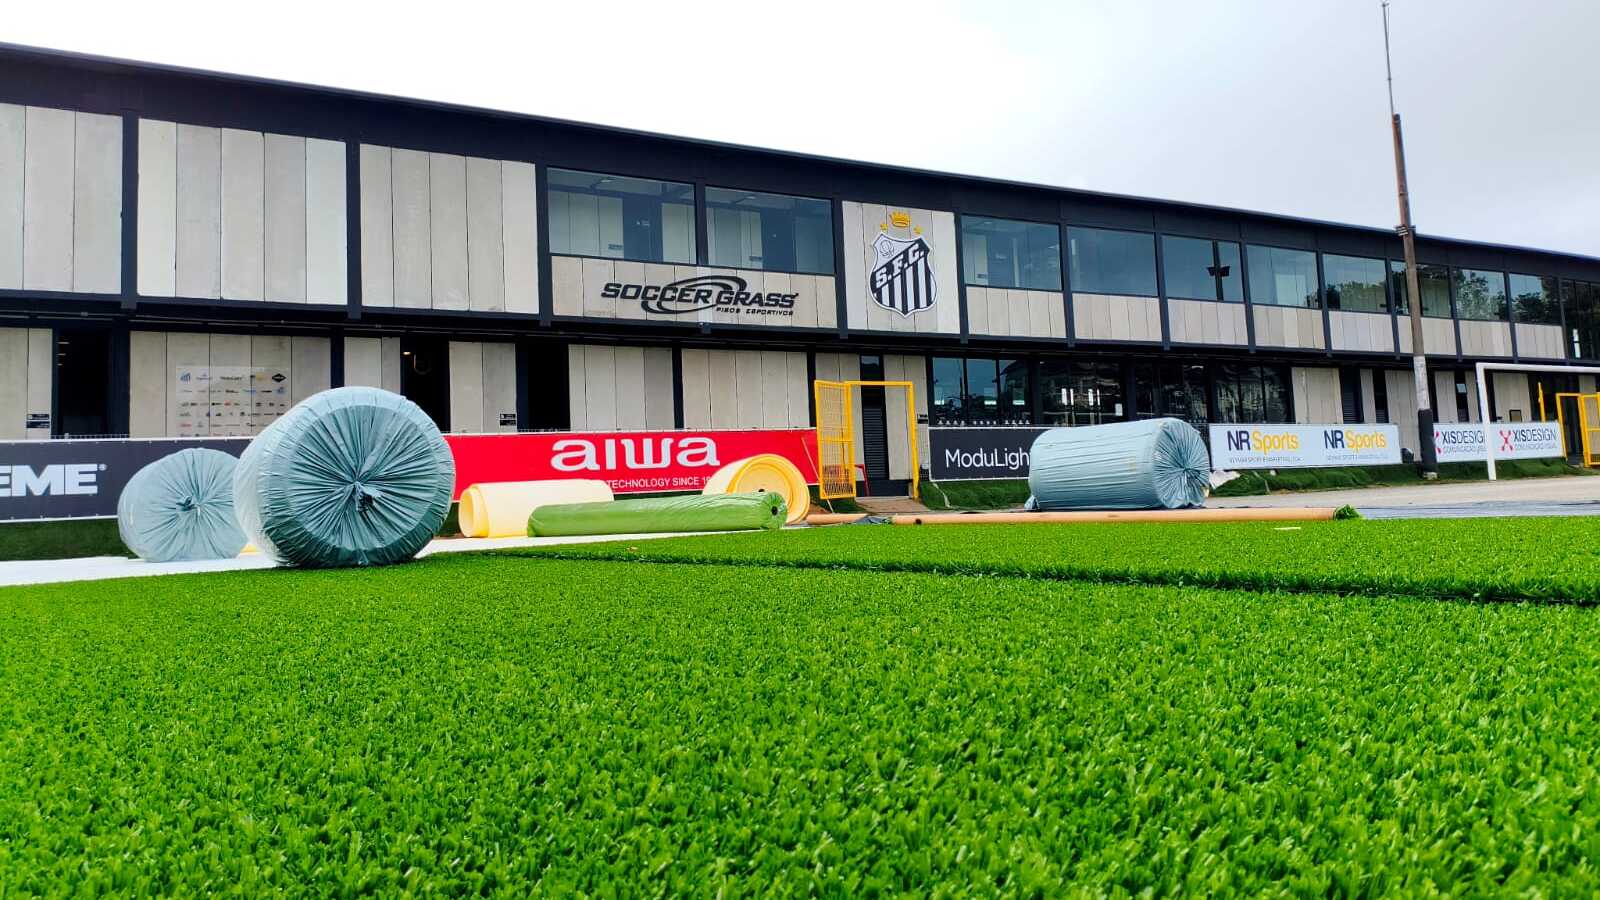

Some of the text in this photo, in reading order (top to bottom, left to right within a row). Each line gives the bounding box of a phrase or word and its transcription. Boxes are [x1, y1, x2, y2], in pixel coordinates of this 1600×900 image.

[875, 242, 925, 289] S.F.C.
[600, 282, 798, 308] SOCCER GRASS
[716, 306, 793, 316] PISOS ESPORTIVOS
[1227, 430, 1299, 455] NR Sports
[1324, 429, 1387, 453] NR Sports
[1441, 430, 1486, 444] XISDESIG
[551, 437, 720, 472] aiwa
[945, 447, 1030, 470] ModuLigh
[607, 477, 671, 489] TECHNOLOGY
[672, 476, 700, 487] SINCE
